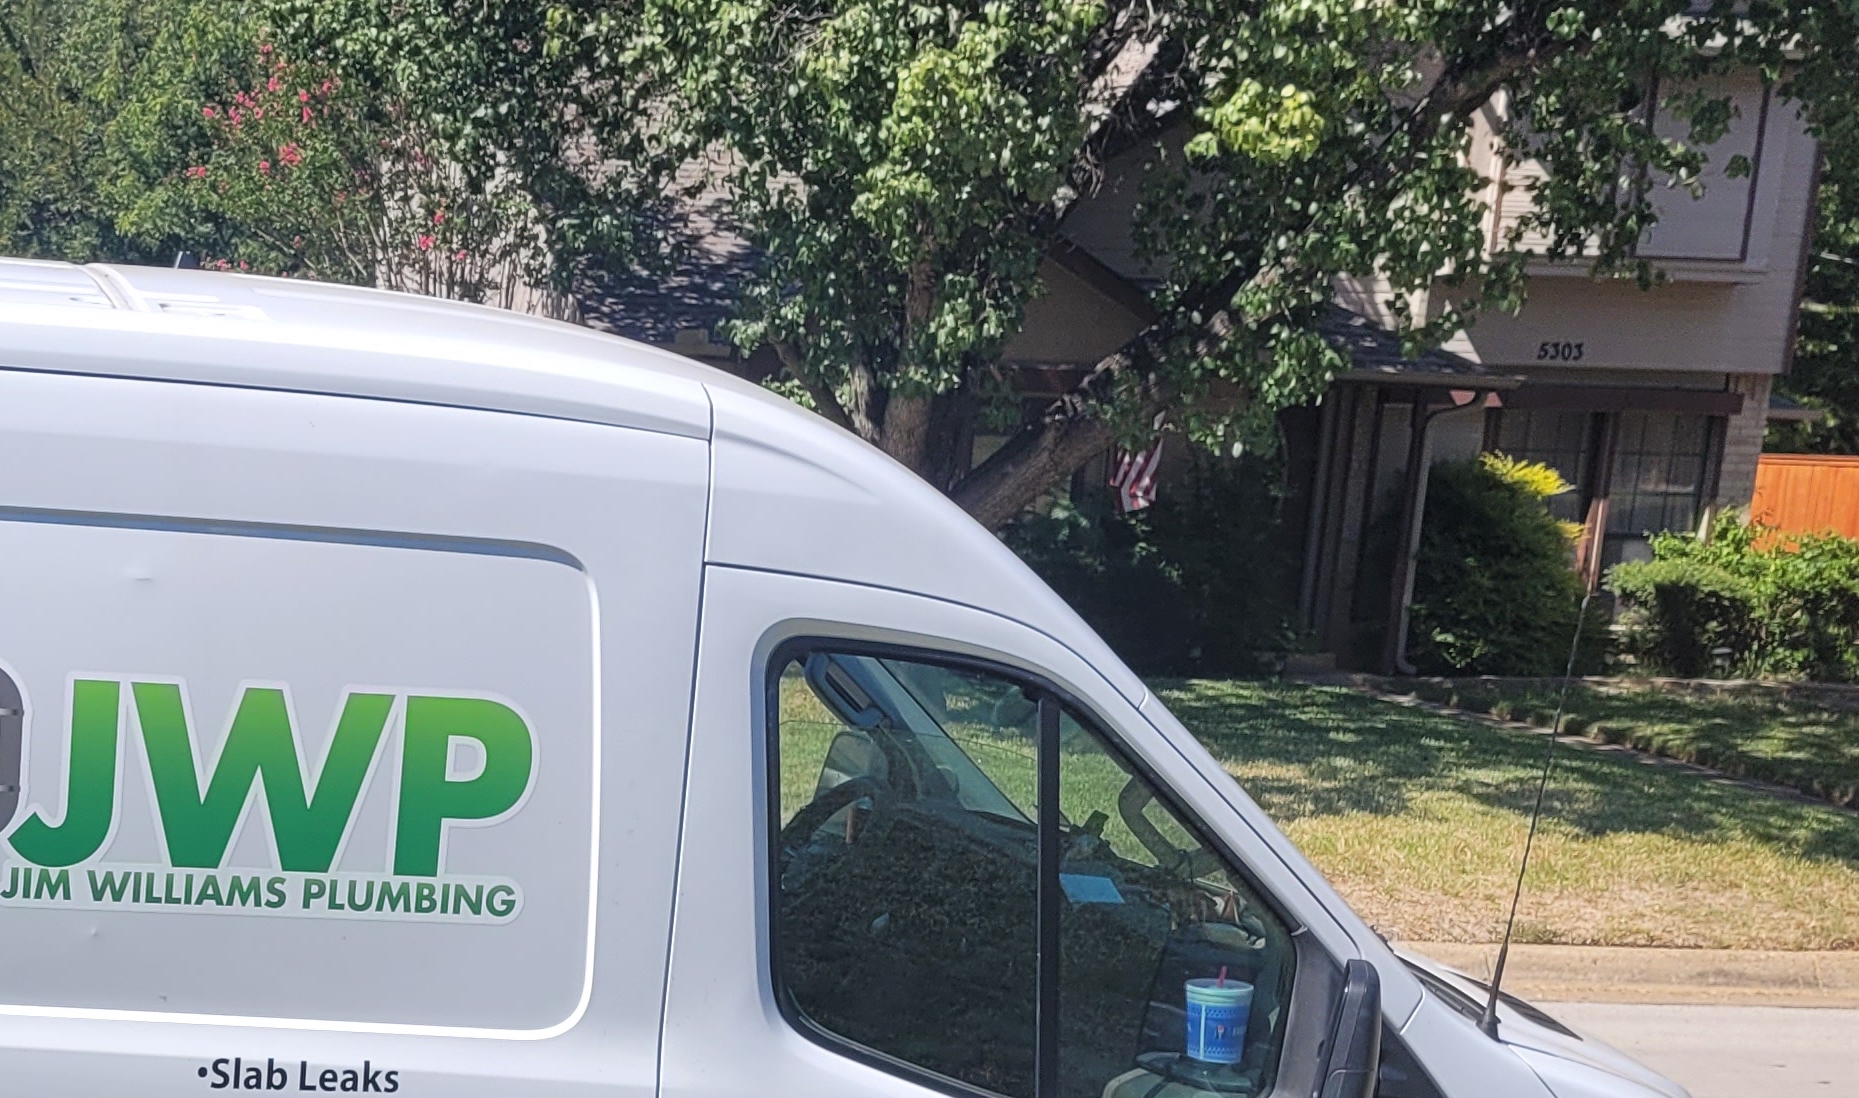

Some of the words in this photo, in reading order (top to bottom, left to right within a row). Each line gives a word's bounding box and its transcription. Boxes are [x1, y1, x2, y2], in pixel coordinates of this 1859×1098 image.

[1536, 341, 1584, 361] 5303
[6, 678, 533, 877] JWP
[0, 867, 71, 900] JIM
[87, 870, 287, 909] WILLIAMS
[302, 878, 517, 917] PLUMBING
[299, 1061, 400, 1094] Leaks
